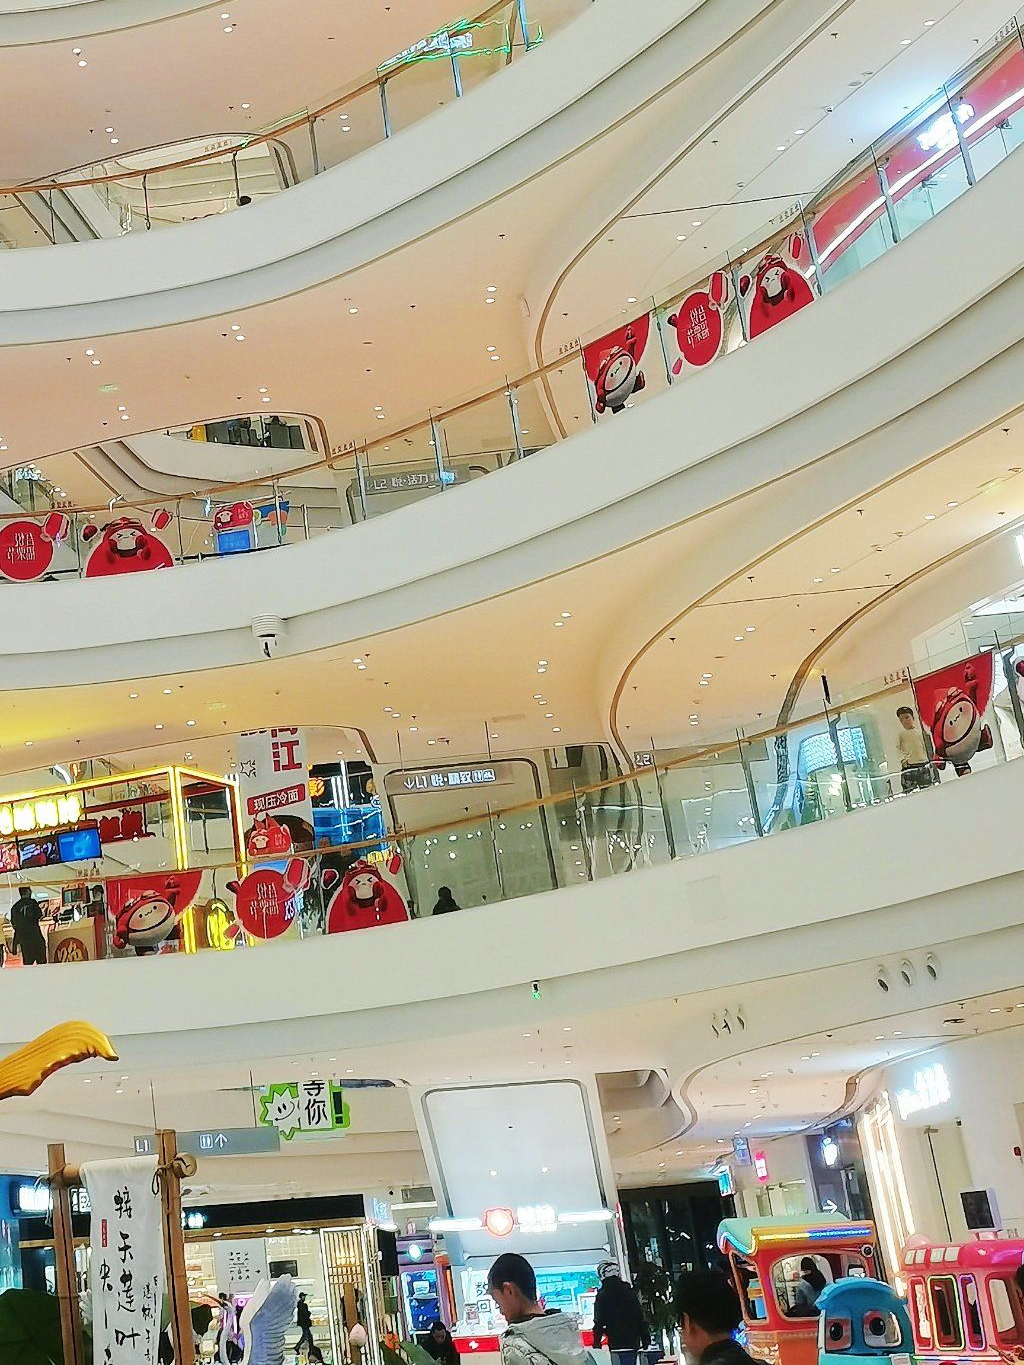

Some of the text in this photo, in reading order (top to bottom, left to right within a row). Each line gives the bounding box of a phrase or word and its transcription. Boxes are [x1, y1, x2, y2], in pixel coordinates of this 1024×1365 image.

[253, 788, 299, 811] 现压冷面
[135, 1139, 150, 1153] L1
